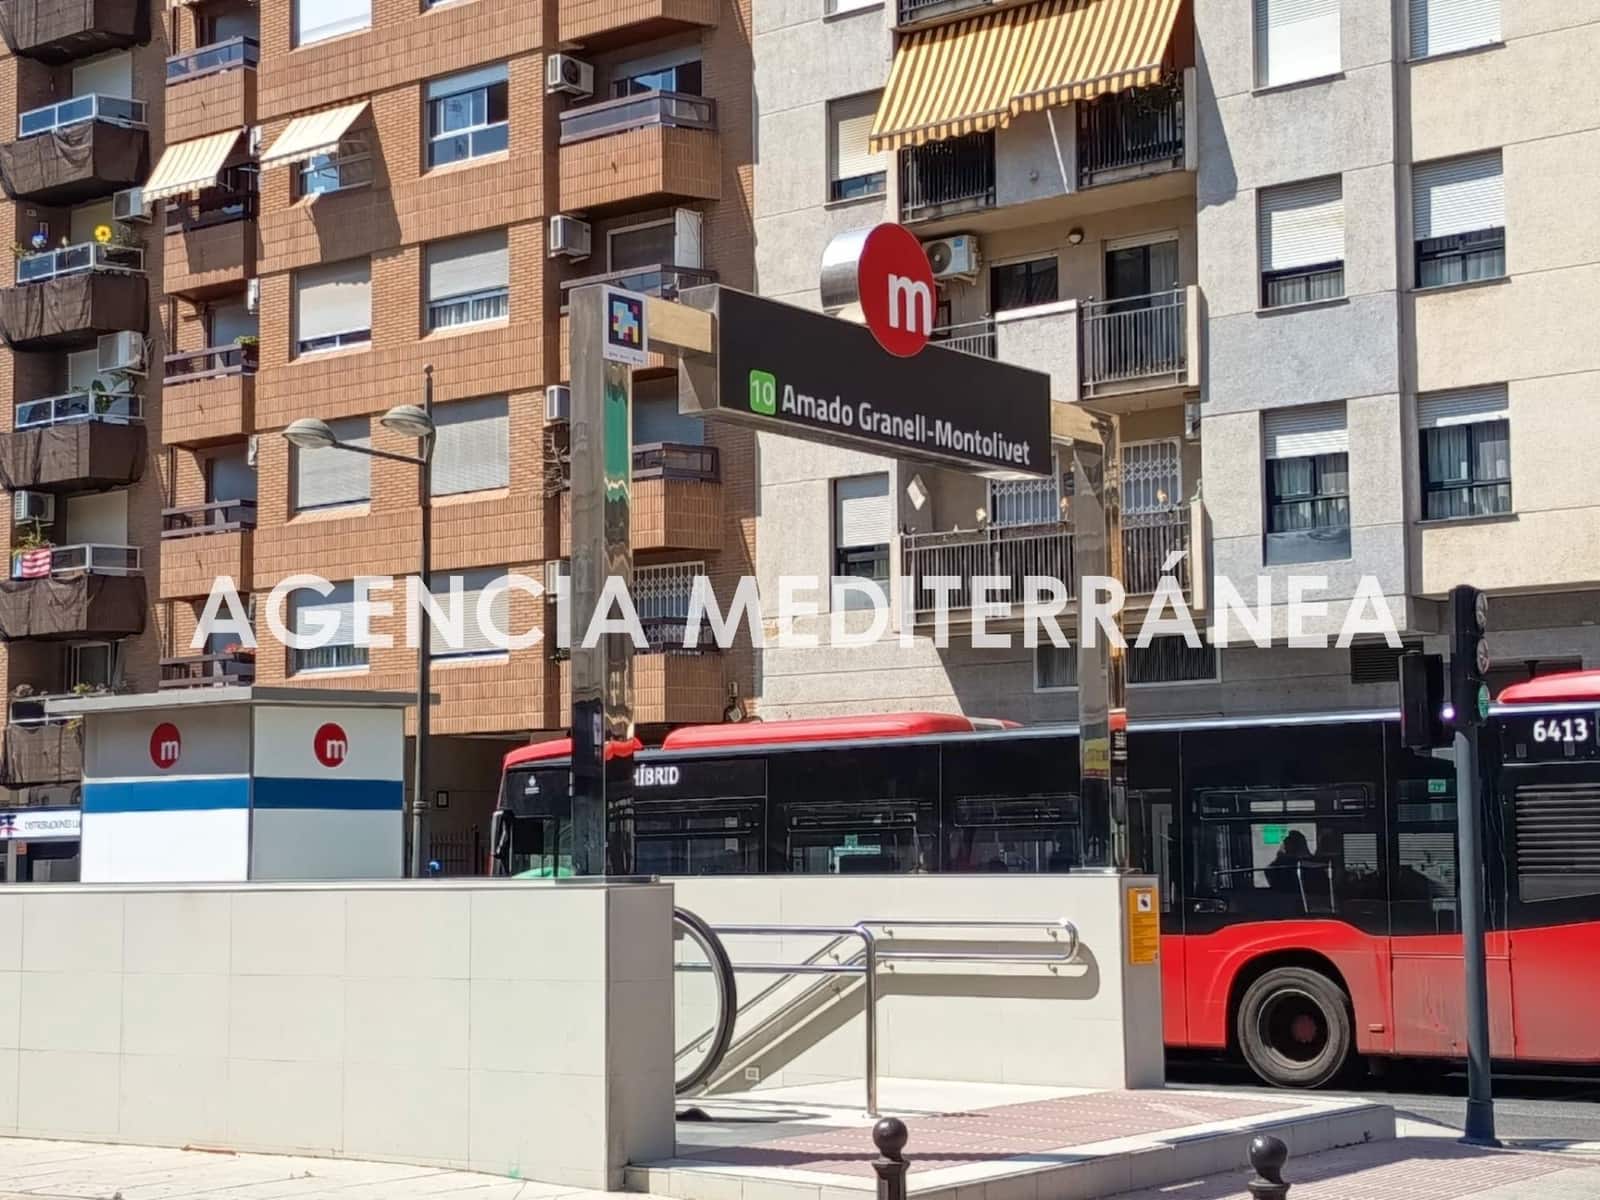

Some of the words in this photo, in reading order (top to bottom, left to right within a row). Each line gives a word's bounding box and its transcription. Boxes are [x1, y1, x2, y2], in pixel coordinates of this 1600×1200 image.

[888, 273, 933, 336] m
[751, 379, 774, 406] 10
[782, 384, 853, 426] Amado
[859, 402, 1030, 465] Granell-Montolivet
[1533, 718, 1588, 742] 6413
[161, 740, 179, 761] m
[326, 740, 346, 760] m
